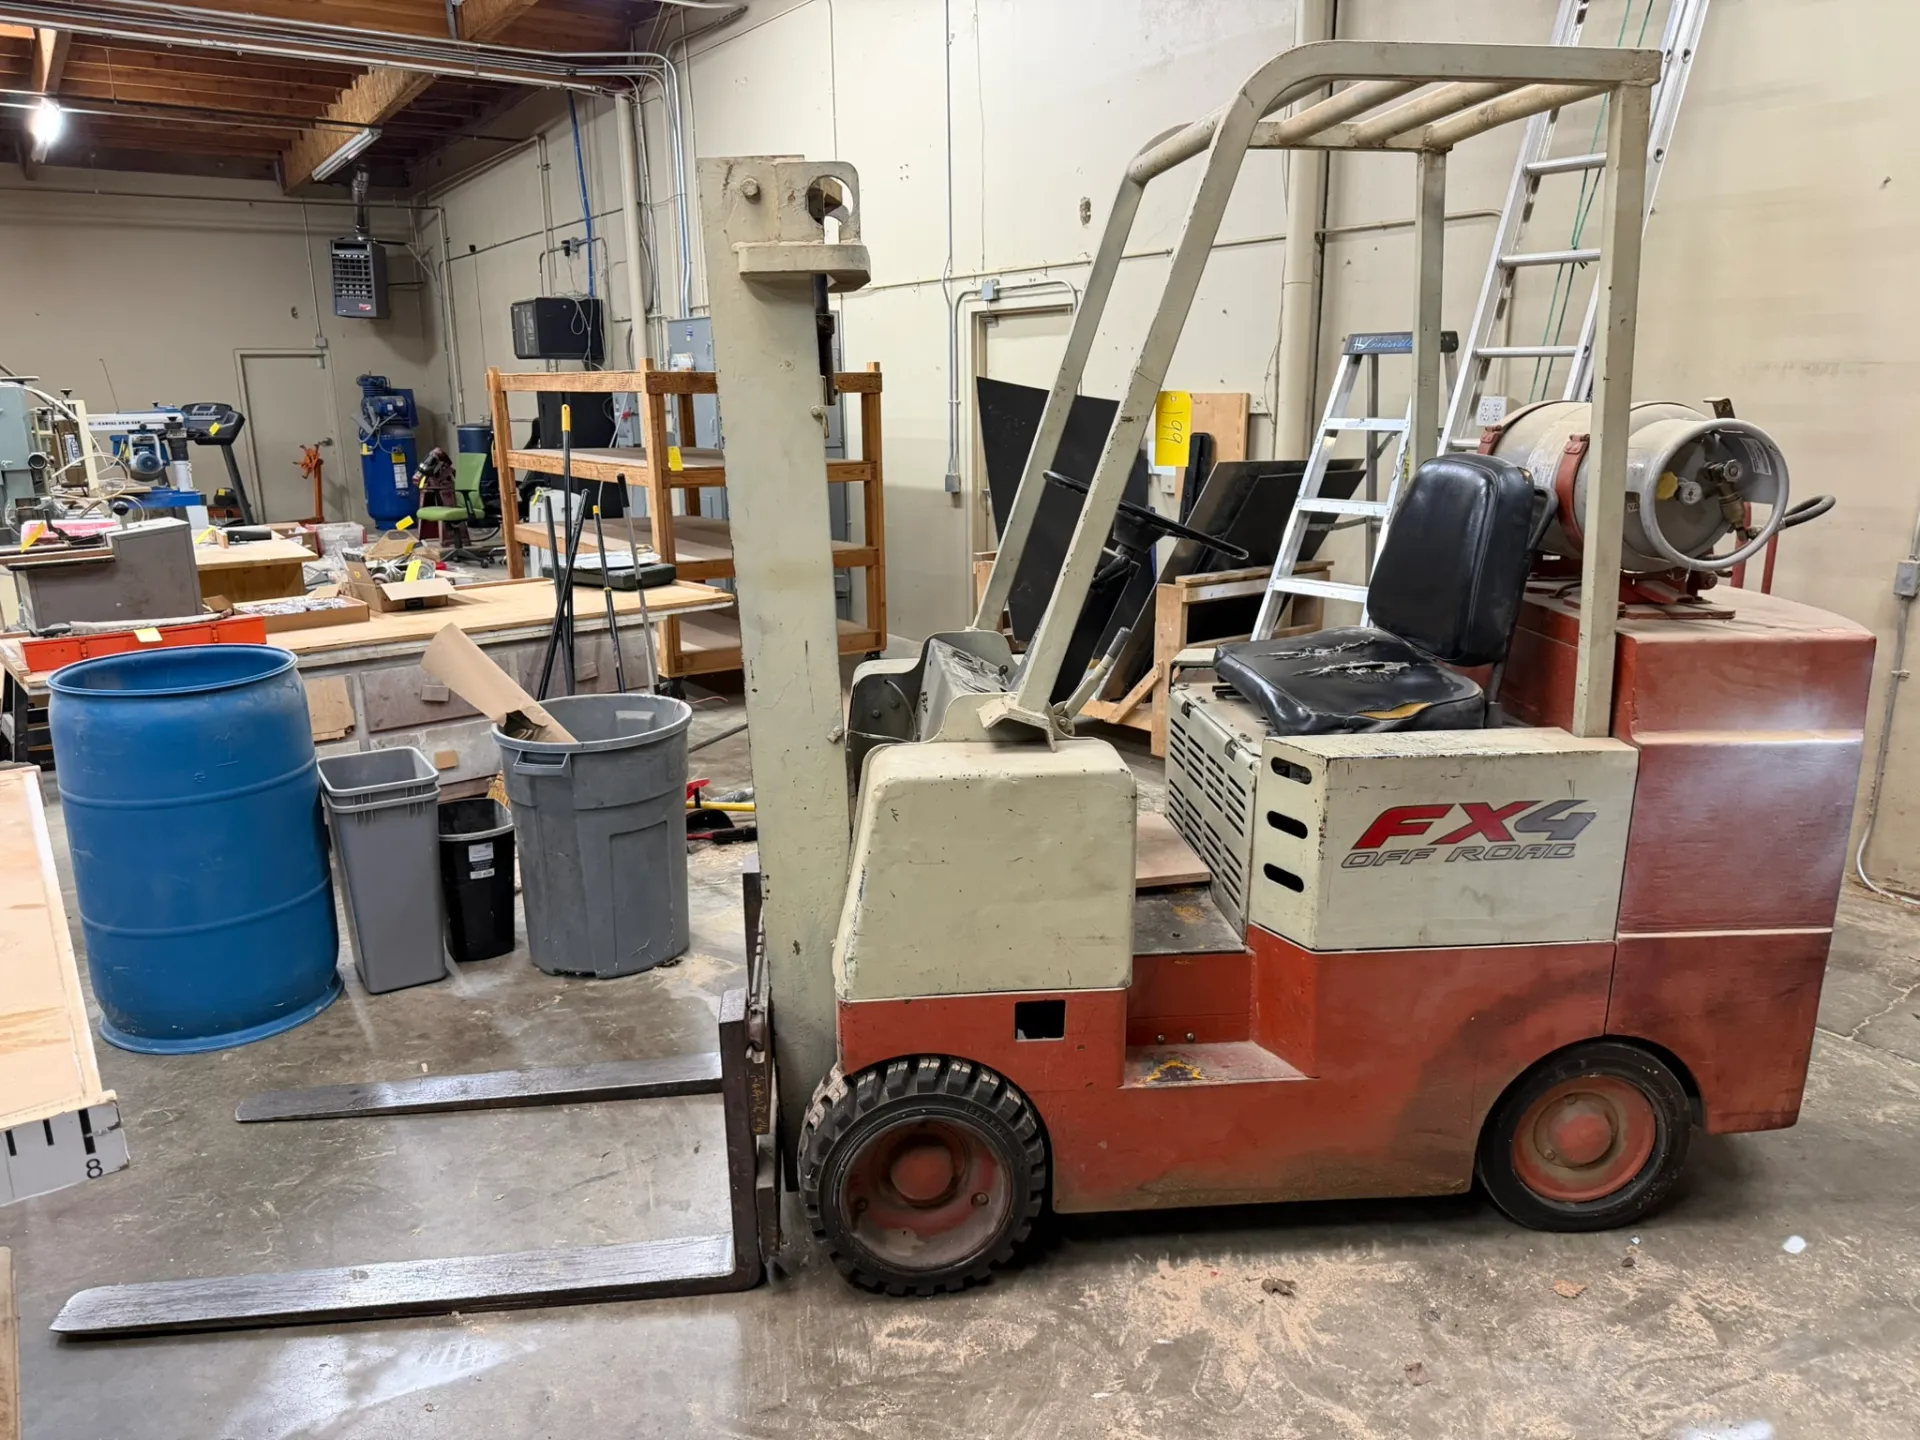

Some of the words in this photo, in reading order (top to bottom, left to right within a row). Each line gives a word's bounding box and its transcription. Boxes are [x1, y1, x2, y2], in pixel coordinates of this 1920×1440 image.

[1351, 800, 1598, 849] FX4
[1341, 848, 1437, 869] OFF
[1444, 843, 1577, 863] ROAD
[86, 1158, 104, 1179] 8
